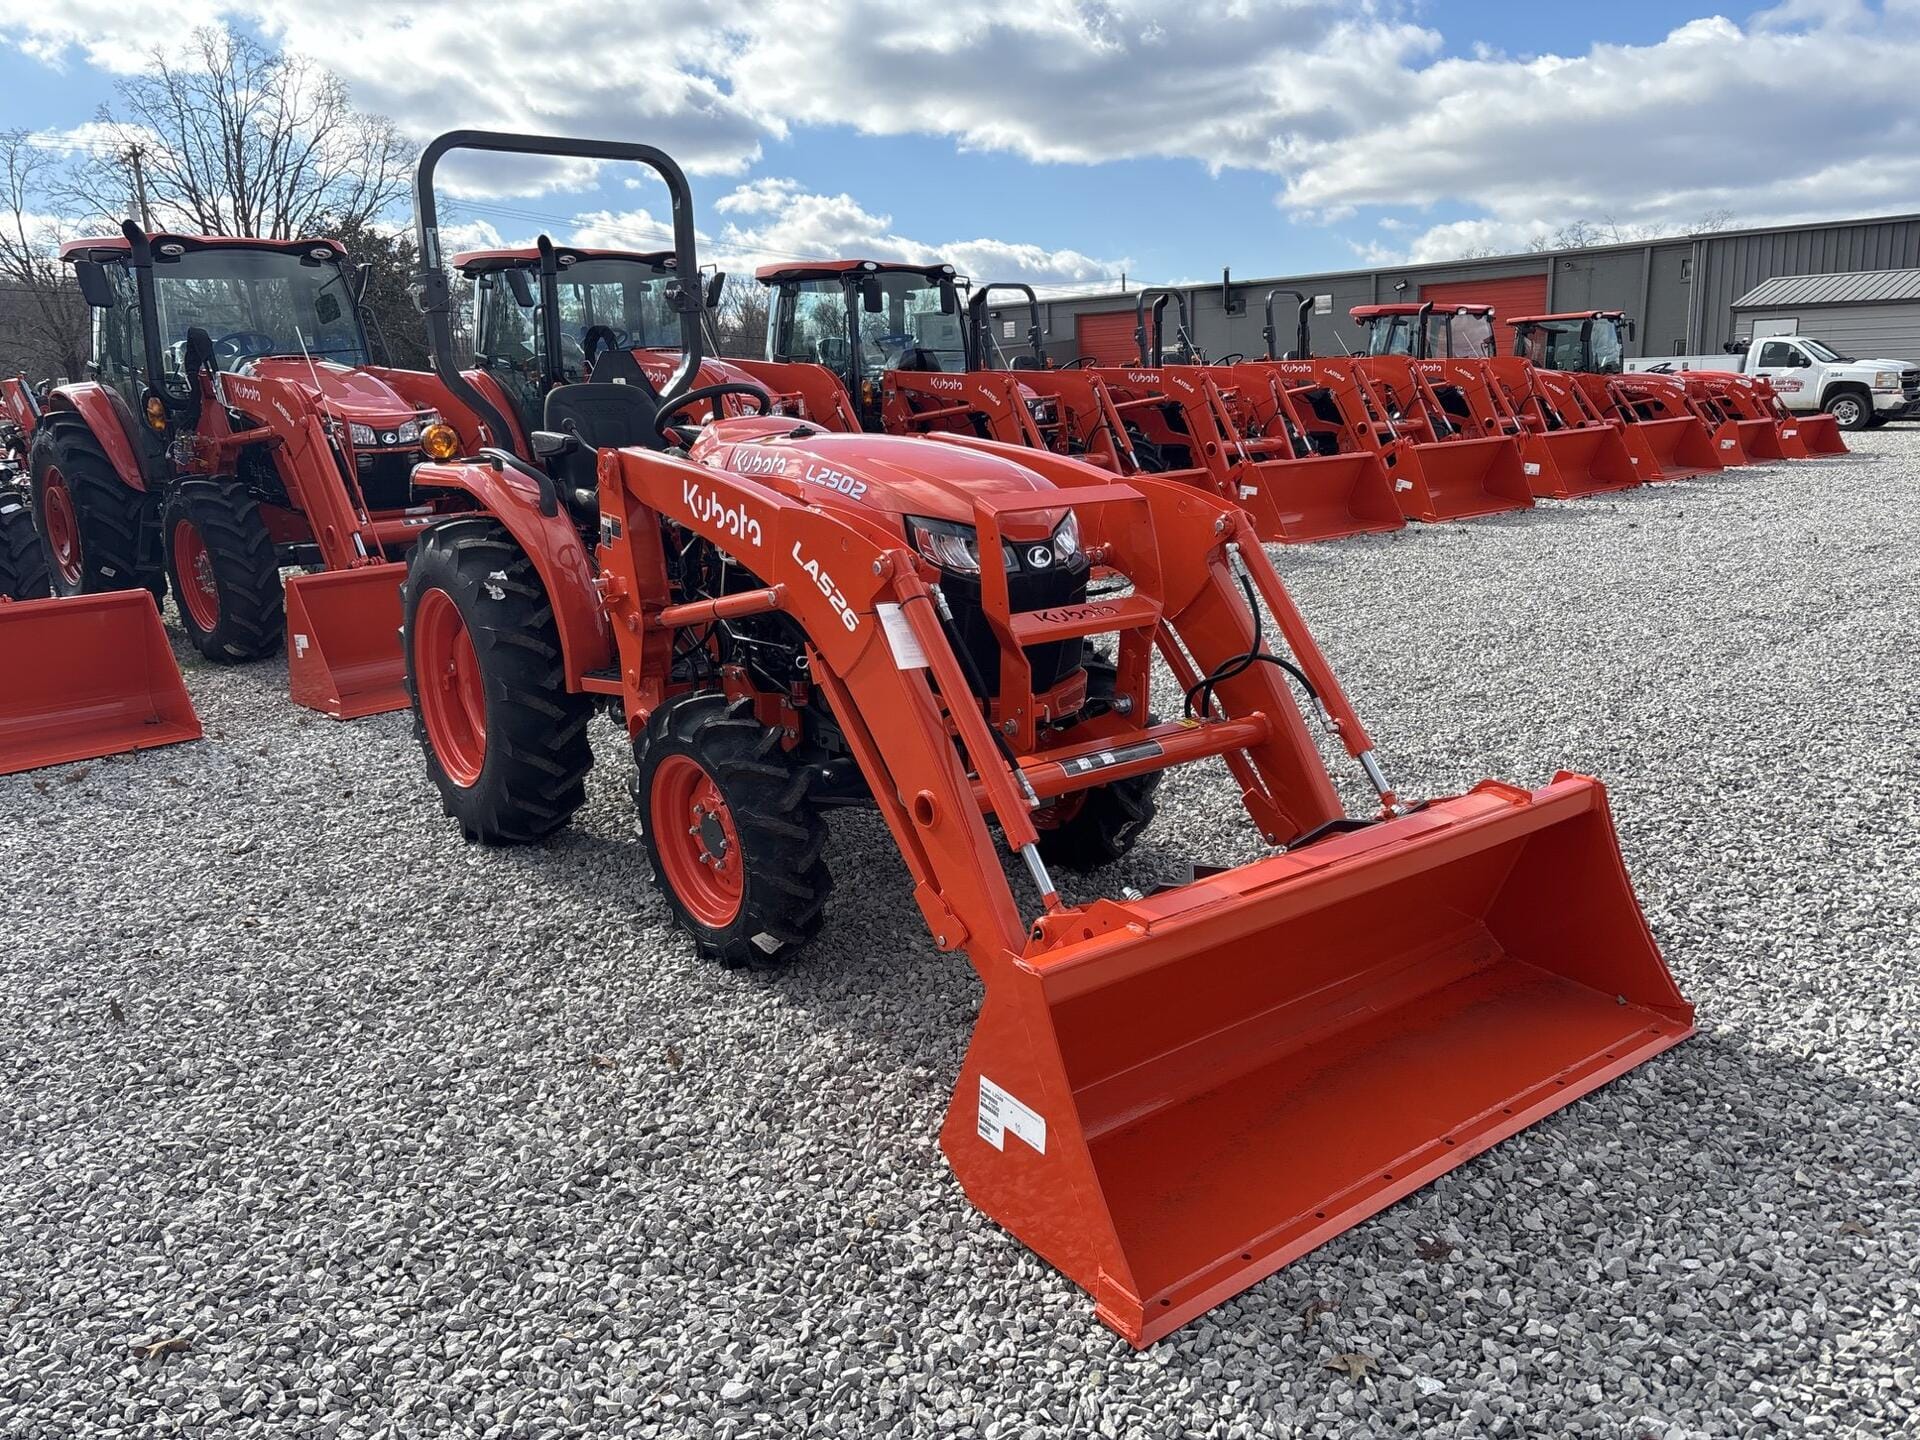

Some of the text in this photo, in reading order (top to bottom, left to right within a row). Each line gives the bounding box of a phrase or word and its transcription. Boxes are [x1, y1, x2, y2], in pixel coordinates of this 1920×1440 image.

[1128, 372, 1160, 383] Kubota
[1281, 363, 1312, 373] Kubota
[234, 381, 261, 402] Kubota
[930, 377, 963, 391] Kubota
[733, 449, 787, 474] Kubota
[805, 464, 868, 500] L2502
[683, 479, 762, 547] Kubota
[792, 540, 860, 632] LA526
[1033, 605, 1119, 623] Kubota
